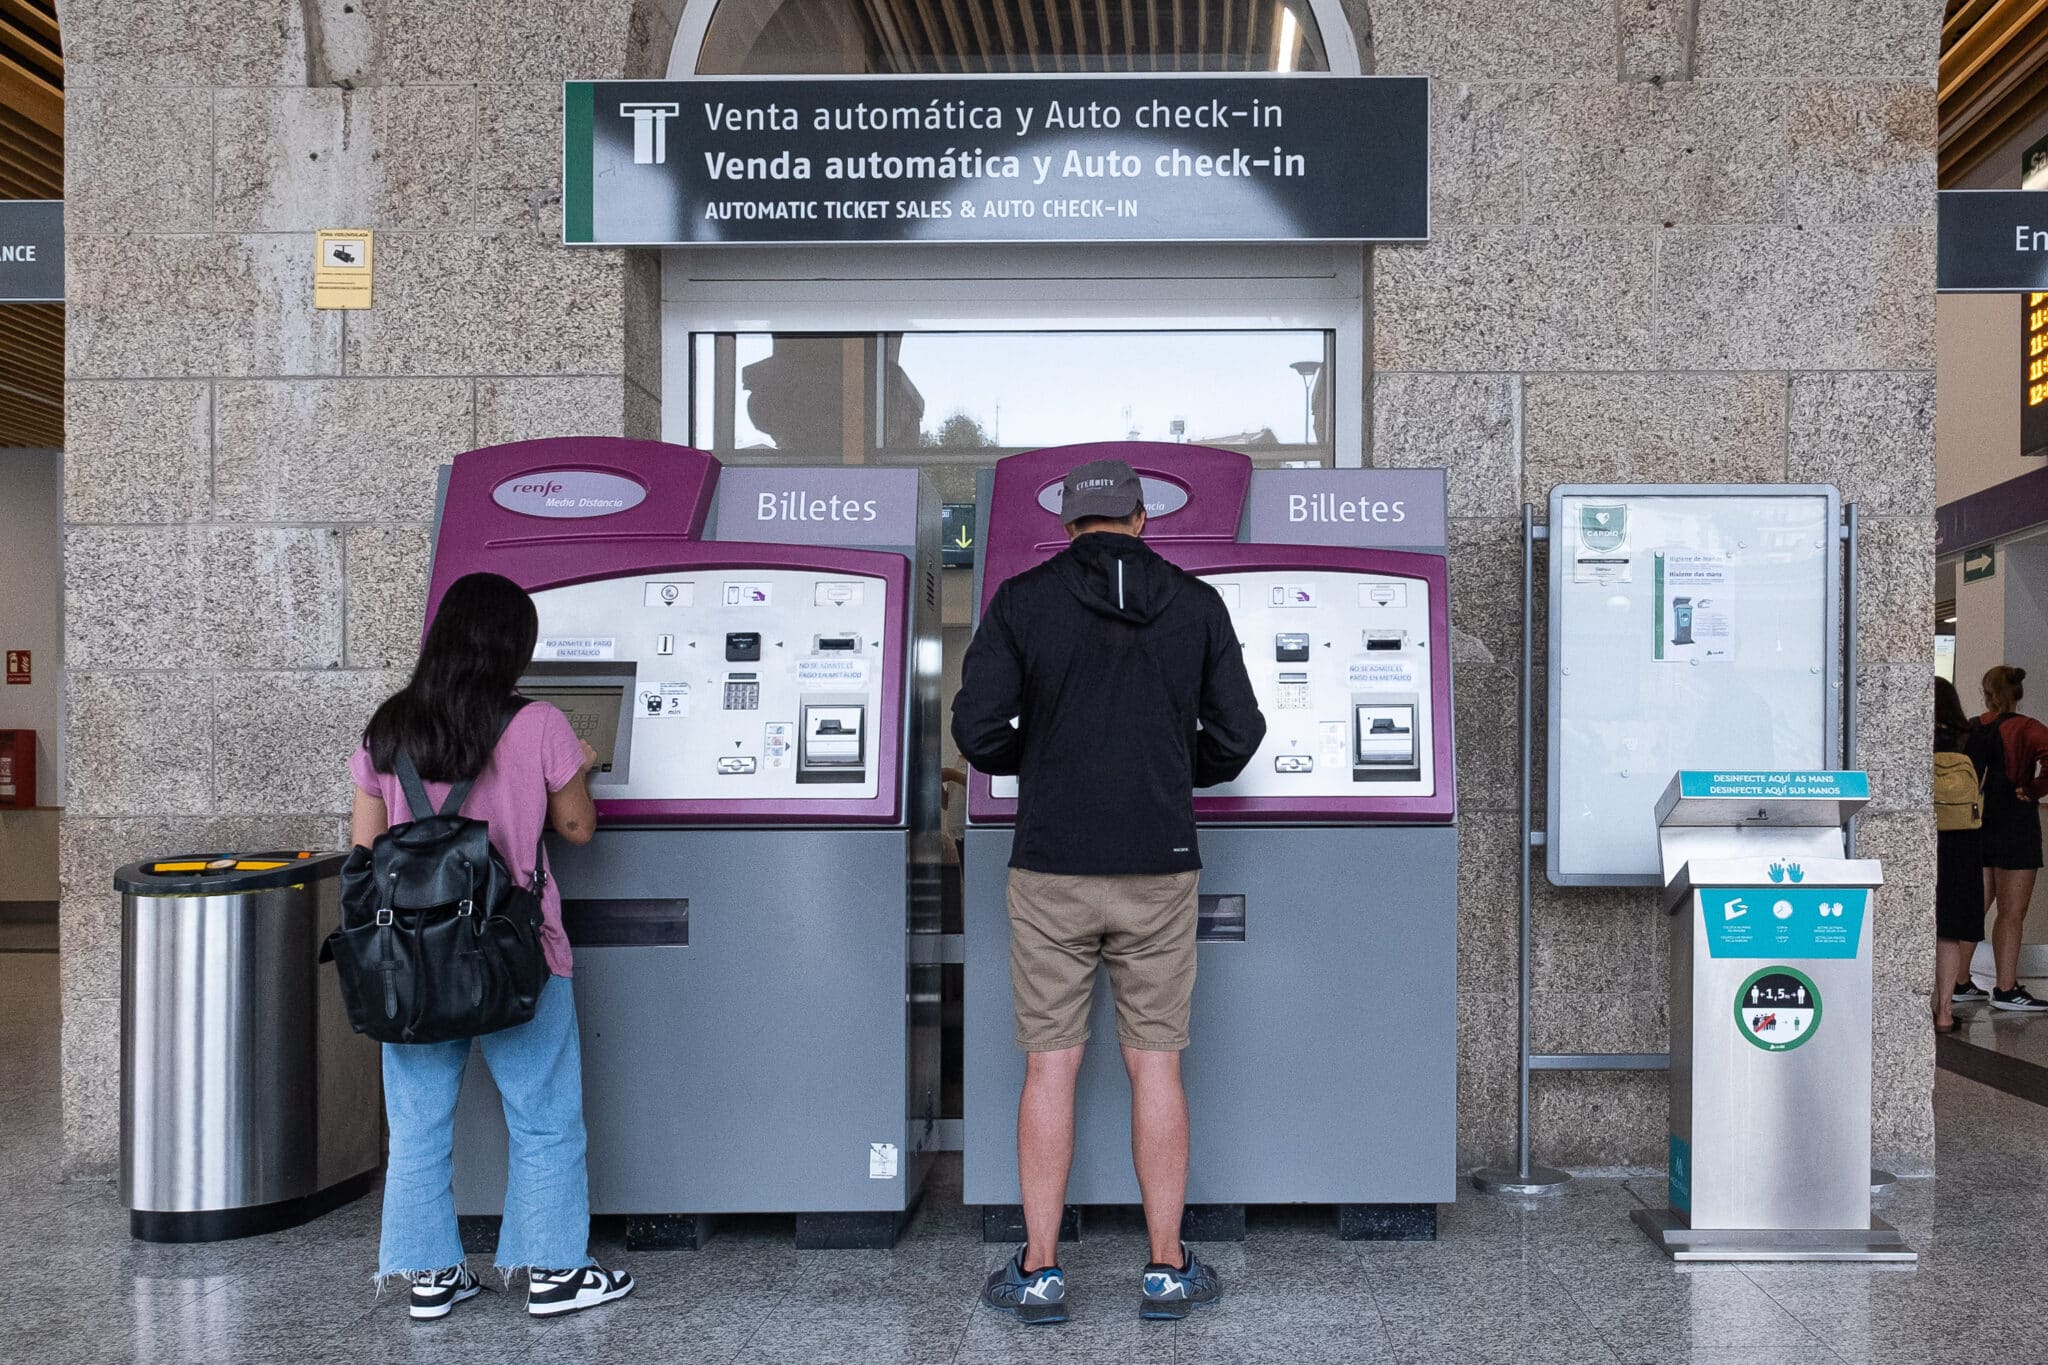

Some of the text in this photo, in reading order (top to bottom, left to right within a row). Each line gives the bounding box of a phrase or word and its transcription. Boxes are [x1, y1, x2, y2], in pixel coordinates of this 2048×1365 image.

[704, 98, 1282, 137] Venta automática y Auto check-in
[704, 146, 1305, 185] Venda automática y Auto check-in
[704, 200, 1138, 220] AUTOMATIC TICKET SALES & AUTO CHECK-IN
[2015, 225, 2048, 252] En
[0, 245, 36, 262] NCE
[513, 480, 562, 498] renfe
[545, 498, 623, 507] Media Distancia
[757, 491, 877, 521] Billetes
[1289, 493, 1406, 523] Billetes
[671, 698, 679, 708] 5
[1713, 773, 1834, 784] DESINFECTE AQUÍ AS MANS
[1709, 786, 1763, 794] DESINFECTE
[1765, 785, 1787, 796] AQUÍ
[1807, 787, 1841, 795] MANOS
